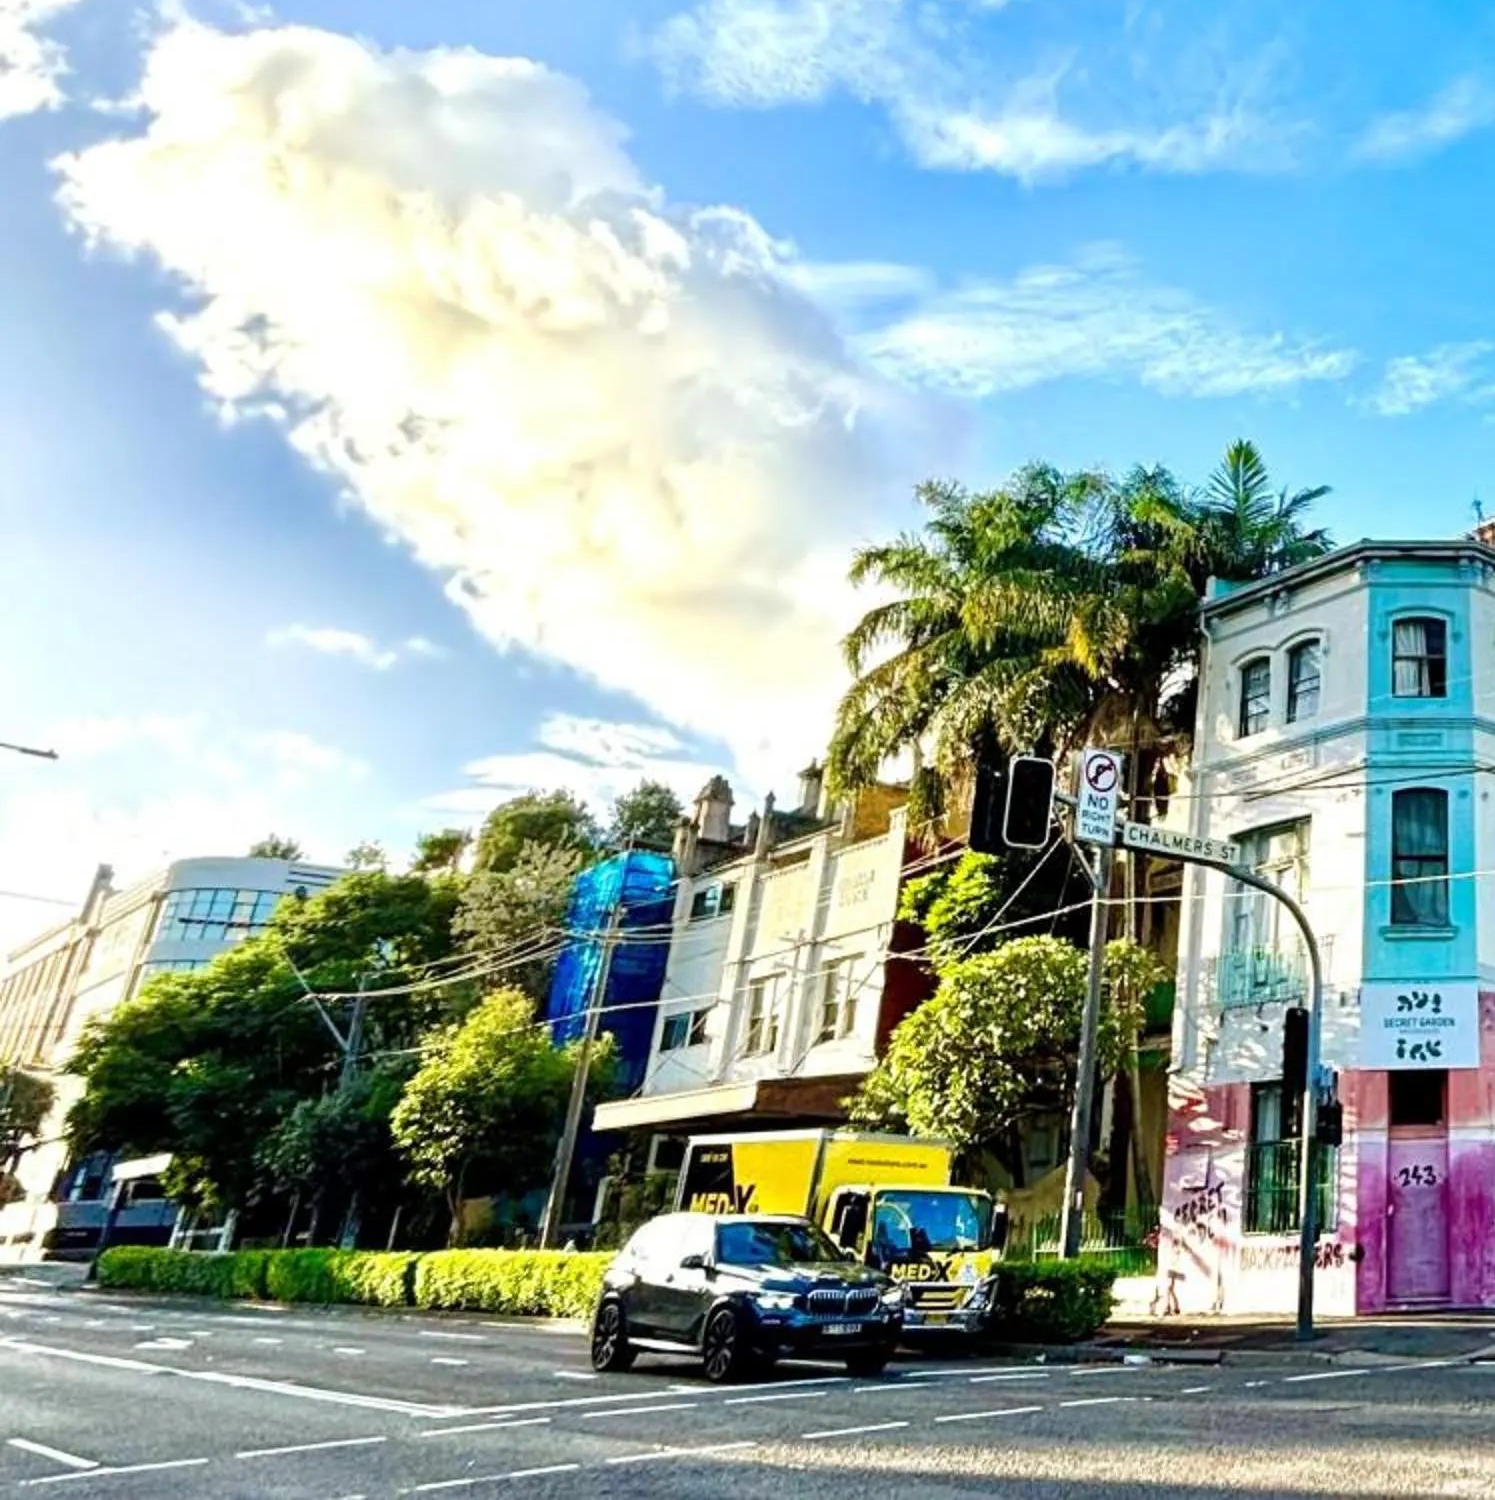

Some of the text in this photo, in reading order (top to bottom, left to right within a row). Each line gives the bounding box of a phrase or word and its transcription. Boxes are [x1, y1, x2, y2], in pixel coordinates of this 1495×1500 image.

[1087, 794, 1109, 810] NO
[1082, 809, 1111, 821] RIGHT
[1082, 822, 1109, 836] TURN
[1129, 827, 1236, 860] CHALMERS ST
[1383, 1017, 1455, 1028] SECRET GARDEN
[1399, 1165, 1436, 1187] 243
[890, 1260, 952, 1282] MED-X
